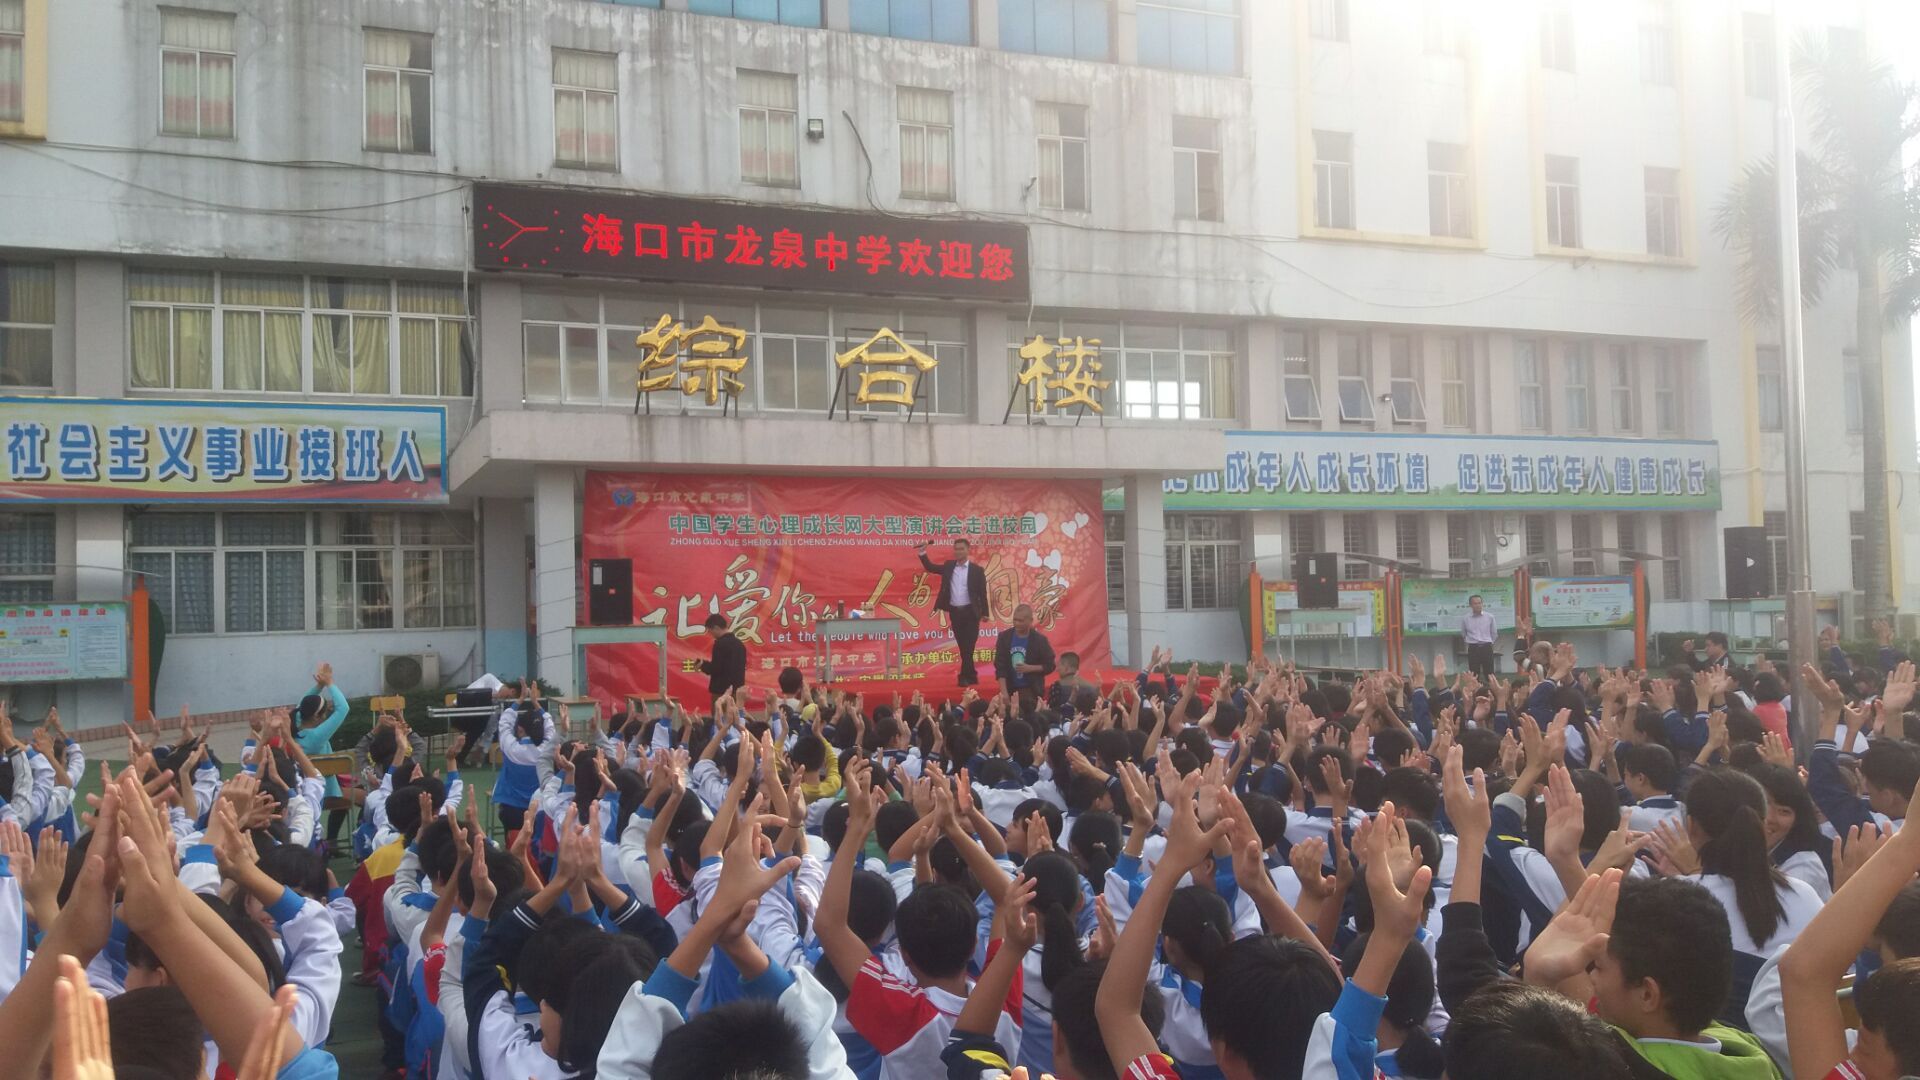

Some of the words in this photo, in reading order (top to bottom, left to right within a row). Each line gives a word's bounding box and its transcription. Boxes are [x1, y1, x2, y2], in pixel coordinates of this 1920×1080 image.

[582, 212, 1016, 281] 海口市龙泉中学欢迎您
[636, 313, 1112, 413] 综合楼
[7, 422, 425, 480] 社会主义事业接班人
[1457, 453, 1706, 495] 促进未成年人健康成长
[669, 512, 1037, 535] 中国学生心理成长网大型演讲会走进校园
[670, 537, 701, 545] ZHONG
[724, 538, 739, 546] XUE
[742, 538, 771, 547] SHENG
[798, 538, 826, 546] CHENG
[828, 538, 856, 546] ZHANG
[857, 538, 881, 546] WANG
[883, 538, 894, 546] DA
[895, 538, 914, 546] XING
[771, 631, 791, 643] Let
[797, 630, 816, 642] the
[925, 629, 943, 641] you
